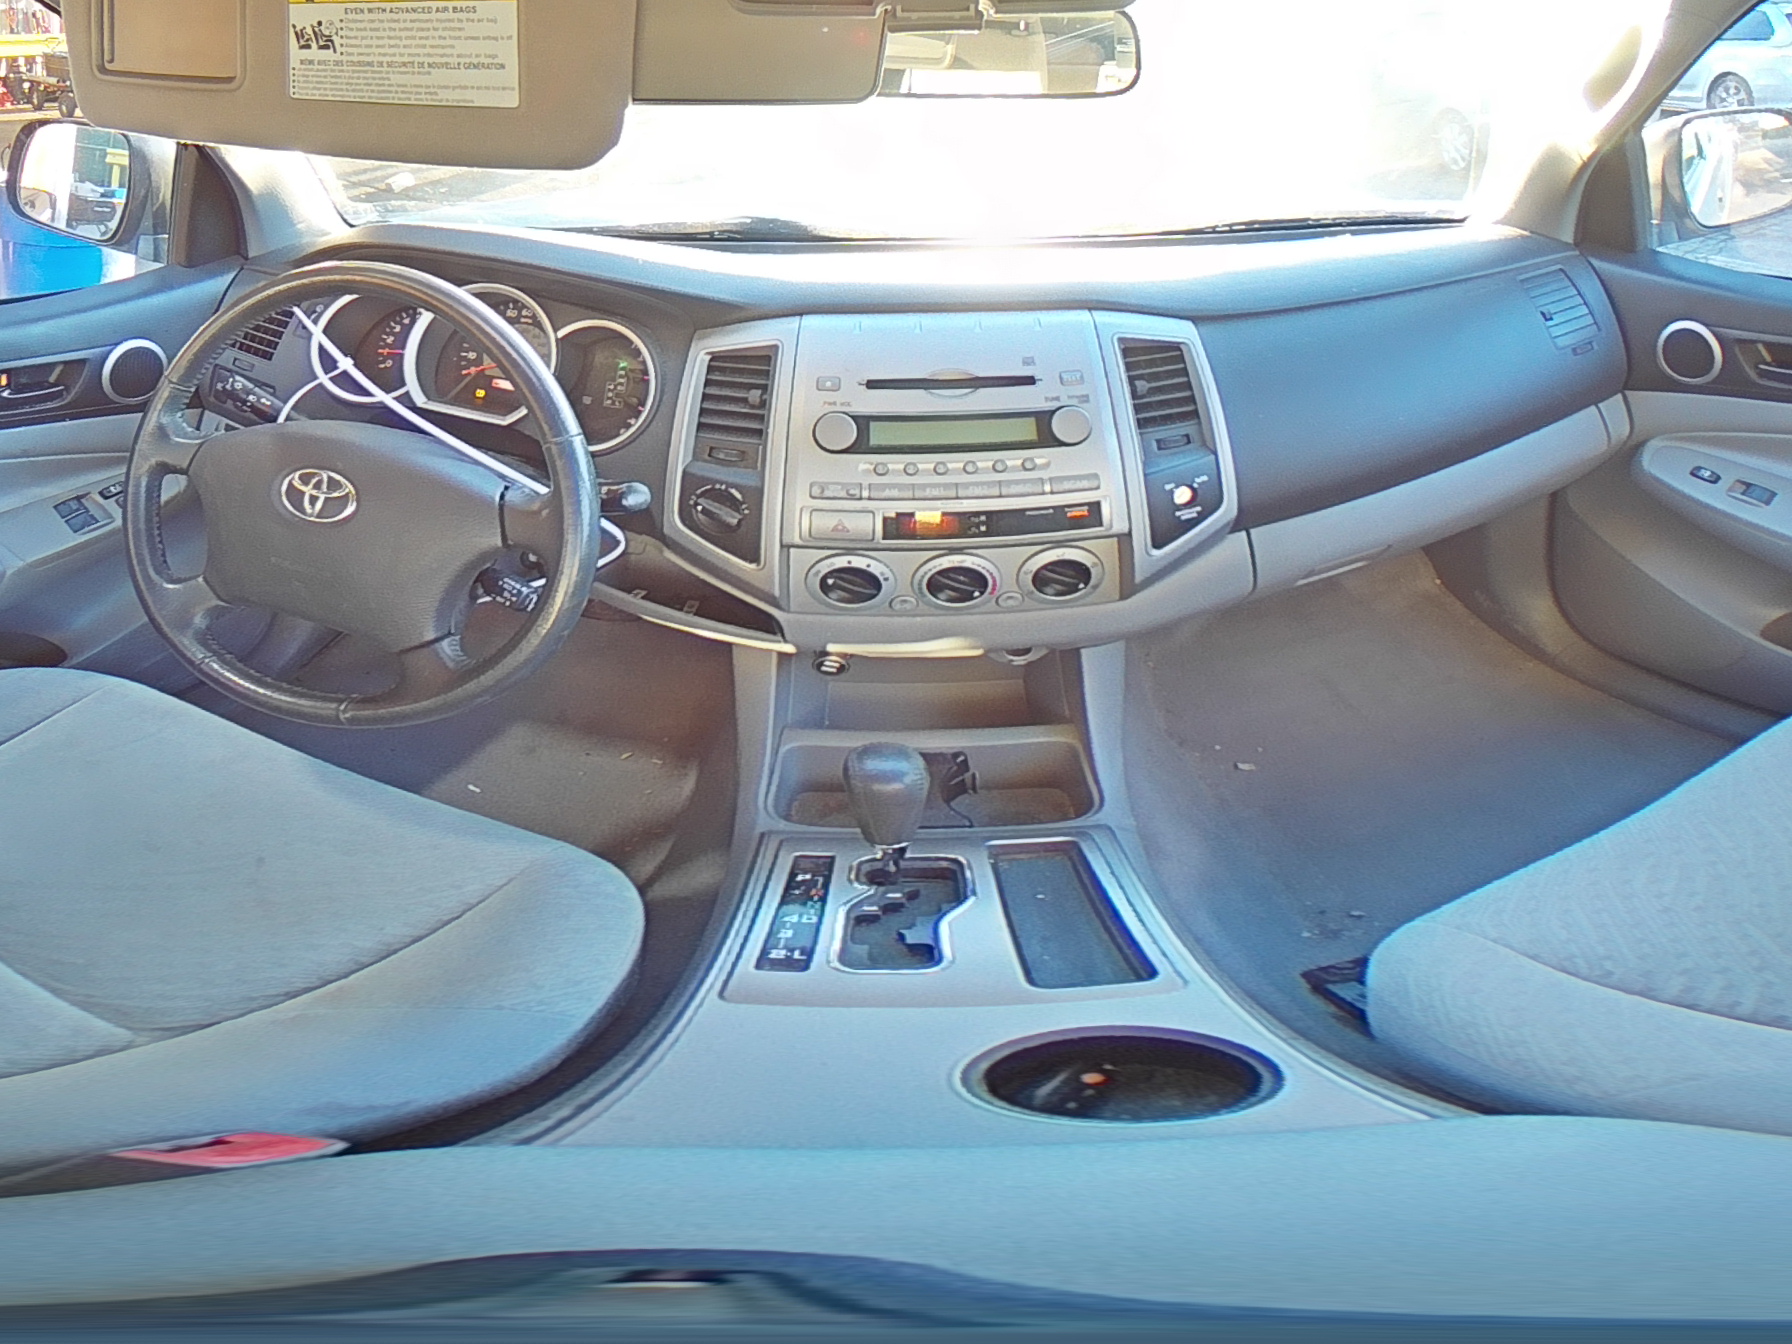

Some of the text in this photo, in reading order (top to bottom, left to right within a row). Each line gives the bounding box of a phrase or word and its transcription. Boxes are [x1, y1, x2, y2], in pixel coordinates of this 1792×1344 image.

[344, 6, 477, 15] EVEN WITH ADVANCED AIR BAGS
